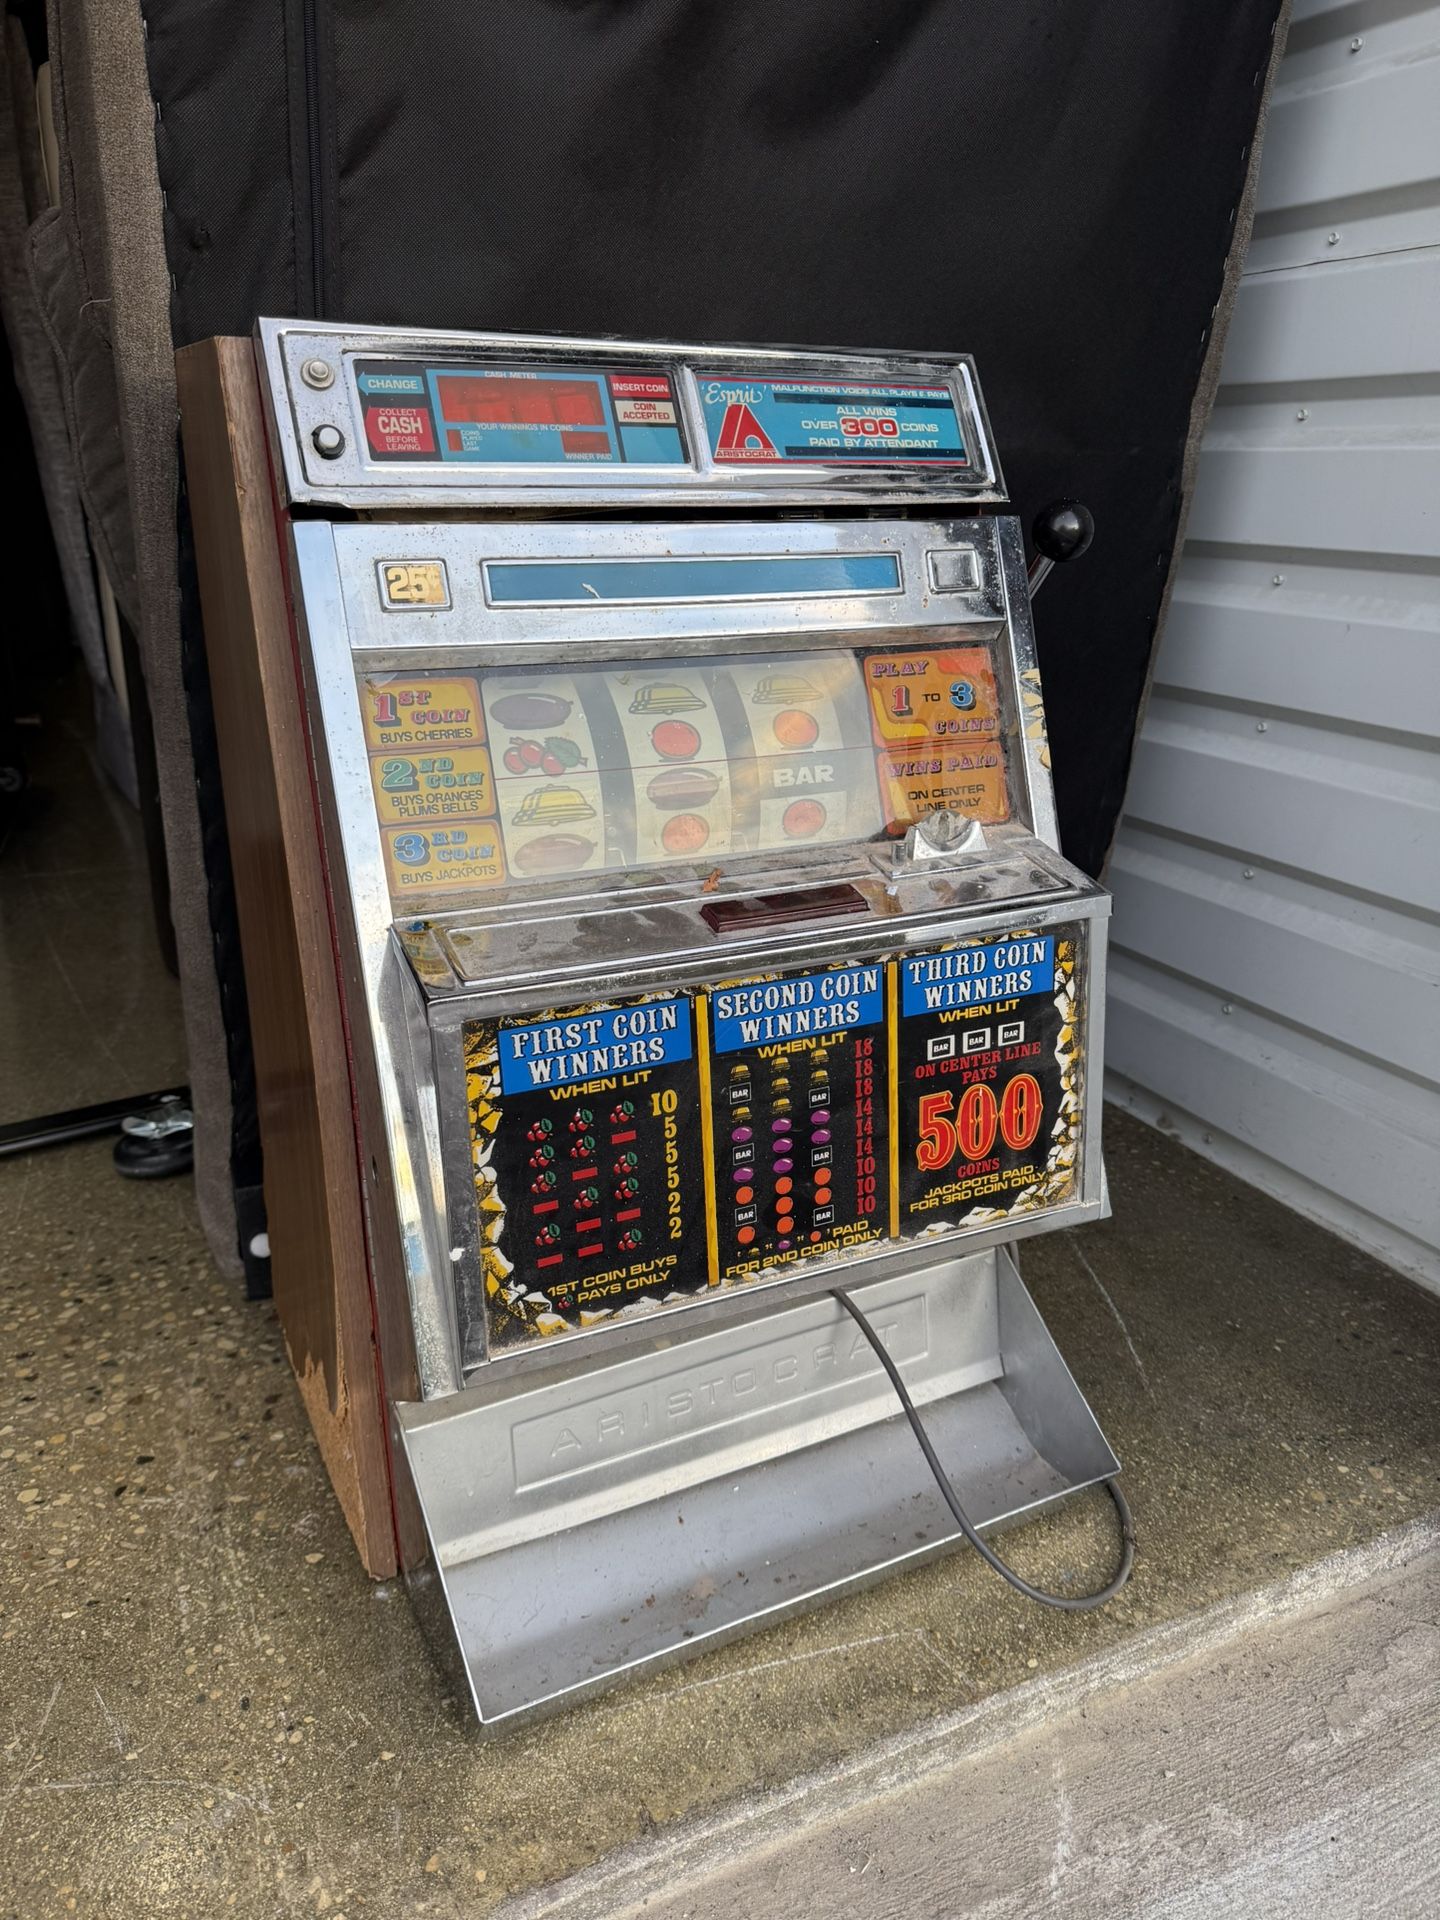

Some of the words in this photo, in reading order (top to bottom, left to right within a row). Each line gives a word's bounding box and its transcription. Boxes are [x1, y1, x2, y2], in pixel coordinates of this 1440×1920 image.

[368, 379, 418, 390] CHANGE
[510, 371, 537, 380] METER
[612, 383, 645, 392] INSERT
[647, 383, 669, 393] COIN
[771, 384, 840, 393] MALFUNCTION
[842, 386, 870, 394] VOIDS
[871, 388, 889, 396] ALL
[889, 389, 918, 397] PLAYS
[927, 391, 949, 399] PAYS
[379, 408, 416, 416] COLLECT
[623, 411, 670, 420] ACCEPTED
[633, 402, 656, 411] COIN
[836, 406, 860, 415] ALL
[863, 407, 897, 417] WINS
[378, 416, 423, 434] CASH
[477, 423, 499, 431] YOUR
[801, 420, 838, 430] OVER
[840, 415, 900, 438] 300
[900, 422, 939, 432] COINS
[386, 443, 421, 451] LEAVING
[809, 437, 839, 447] PAID
[844, 438, 860, 447] BY
[864, 438, 938, 448] ATTENDANT
[872, 661, 929, 678] PLAY
[373, 690, 432, 728] 1ST
[410, 708, 470, 725] COIN
[892, 684, 914, 716] 1
[923, 692, 941, 702] TO
[950, 680, 976, 711] 3
[380, 729, 414, 743] BUYS
[414, 727, 473, 741] CHERRIES
[934, 717, 996, 735] COINS
[381, 756, 455, 793] 2ND
[424, 772, 485, 788] COIN
[773, 763, 835, 788] BAR
[888, 759, 943, 778] WINS
[946, 753, 998, 772] PAID
[391, 793, 425, 807] BUYS
[425, 789, 484, 802] ORANGES
[907, 788, 930, 800] ON
[932, 783, 986, 798] CENTER
[399, 803, 439, 816] PLUMS
[441, 800, 479, 813] BELLS
[916, 800, 946, 813] LINE
[948, 796, 982, 809] ONLY
[393, 830, 468, 867] 3RD
[436, 844, 496, 862] COIN
[400, 870, 434, 885] BUYS
[435, 864, 497, 881] JACKPOTS
[908, 950, 987, 985] THIRD
[993, 940, 1047, 969] COIN
[717, 981, 815, 1020] SECOND
[820, 969, 879, 1002] COIN
[924, 970, 1033, 1010] WINNERS
[739, 1000, 861, 1044] WINNERS
[938, 1003, 992, 1024] WHEN
[995, 998, 1020, 1013] LIT
[512, 1018, 603, 1059] FIRST
[612, 1004, 677, 1039] COIN
[933, 1042, 950, 1053] BAR
[968, 1035, 985, 1046] BAR
[1003, 1029, 1019, 1040] BAR
[757, 1036, 817, 1060] WHEN
[821, 1031, 848, 1048] LIT
[854, 1038, 873, 1059] 18
[527, 1036, 666, 1085] WINNERS
[914, 1063, 937, 1080] ON
[939, 1050, 1001, 1074] CENTER
[1004, 1042, 1041, 1061] LINE
[549, 1076, 618, 1101] WHEN
[621, 1070, 653, 1088] LIT
[731, 1088, 749, 1100] BAR
[854, 1058, 874, 1078] 18
[961, 1065, 998, 1086] PAYS
[811, 1092, 827, 1103] BAR
[855, 1077, 874, 1098] 18
[651, 1089, 678, 1117] 10
[855, 1097, 873, 1118] 14
[664, 1115, 677, 1139] 5
[915, 1072, 1044, 1172] 500
[735, 1149, 752, 1161] BAR
[855, 1116, 873, 1137] 14
[814, 1151, 830, 1162] BAR
[856, 1136, 873, 1157] 14
[665, 1140, 678, 1164] 5
[667, 1165, 680, 1189] 5
[856, 1156, 876, 1177] 10
[957, 1157, 1000, 1179] COINS
[909, 1198, 940, 1214] FOR
[942, 1192, 972, 1206] 3RD
[973, 1181, 1008, 1197] COIN
[1010, 1172, 1046, 1188] ONLY
[923, 1172, 999, 1200] JACKPOTS
[1002, 1164, 1034, 1180] PAID
[668, 1191, 681, 1215] 2
[737, 1212, 754, 1222] BAR
[856, 1175, 877, 1196] 10
[816, 1211, 831, 1222] BAR
[856, 1195, 877, 1216] 10
[669, 1216, 682, 1240] 2
[832, 1219, 869, 1238] PAID
[726, 1259, 761, 1278] FOR
[762, 1249, 799, 1268] 2ND
[800, 1237, 840, 1257] COIN
[842, 1227, 884, 1247] ONLY
[547, 1279, 580, 1298] 1ST
[581, 1266, 627, 1289] COIN
[629, 1254, 679, 1276] BUYS
[577, 1283, 622, 1304] PAYS
[625, 1270, 671, 1291] ONLY
[550, 1321, 899, 1458] ARISTOCRAT
